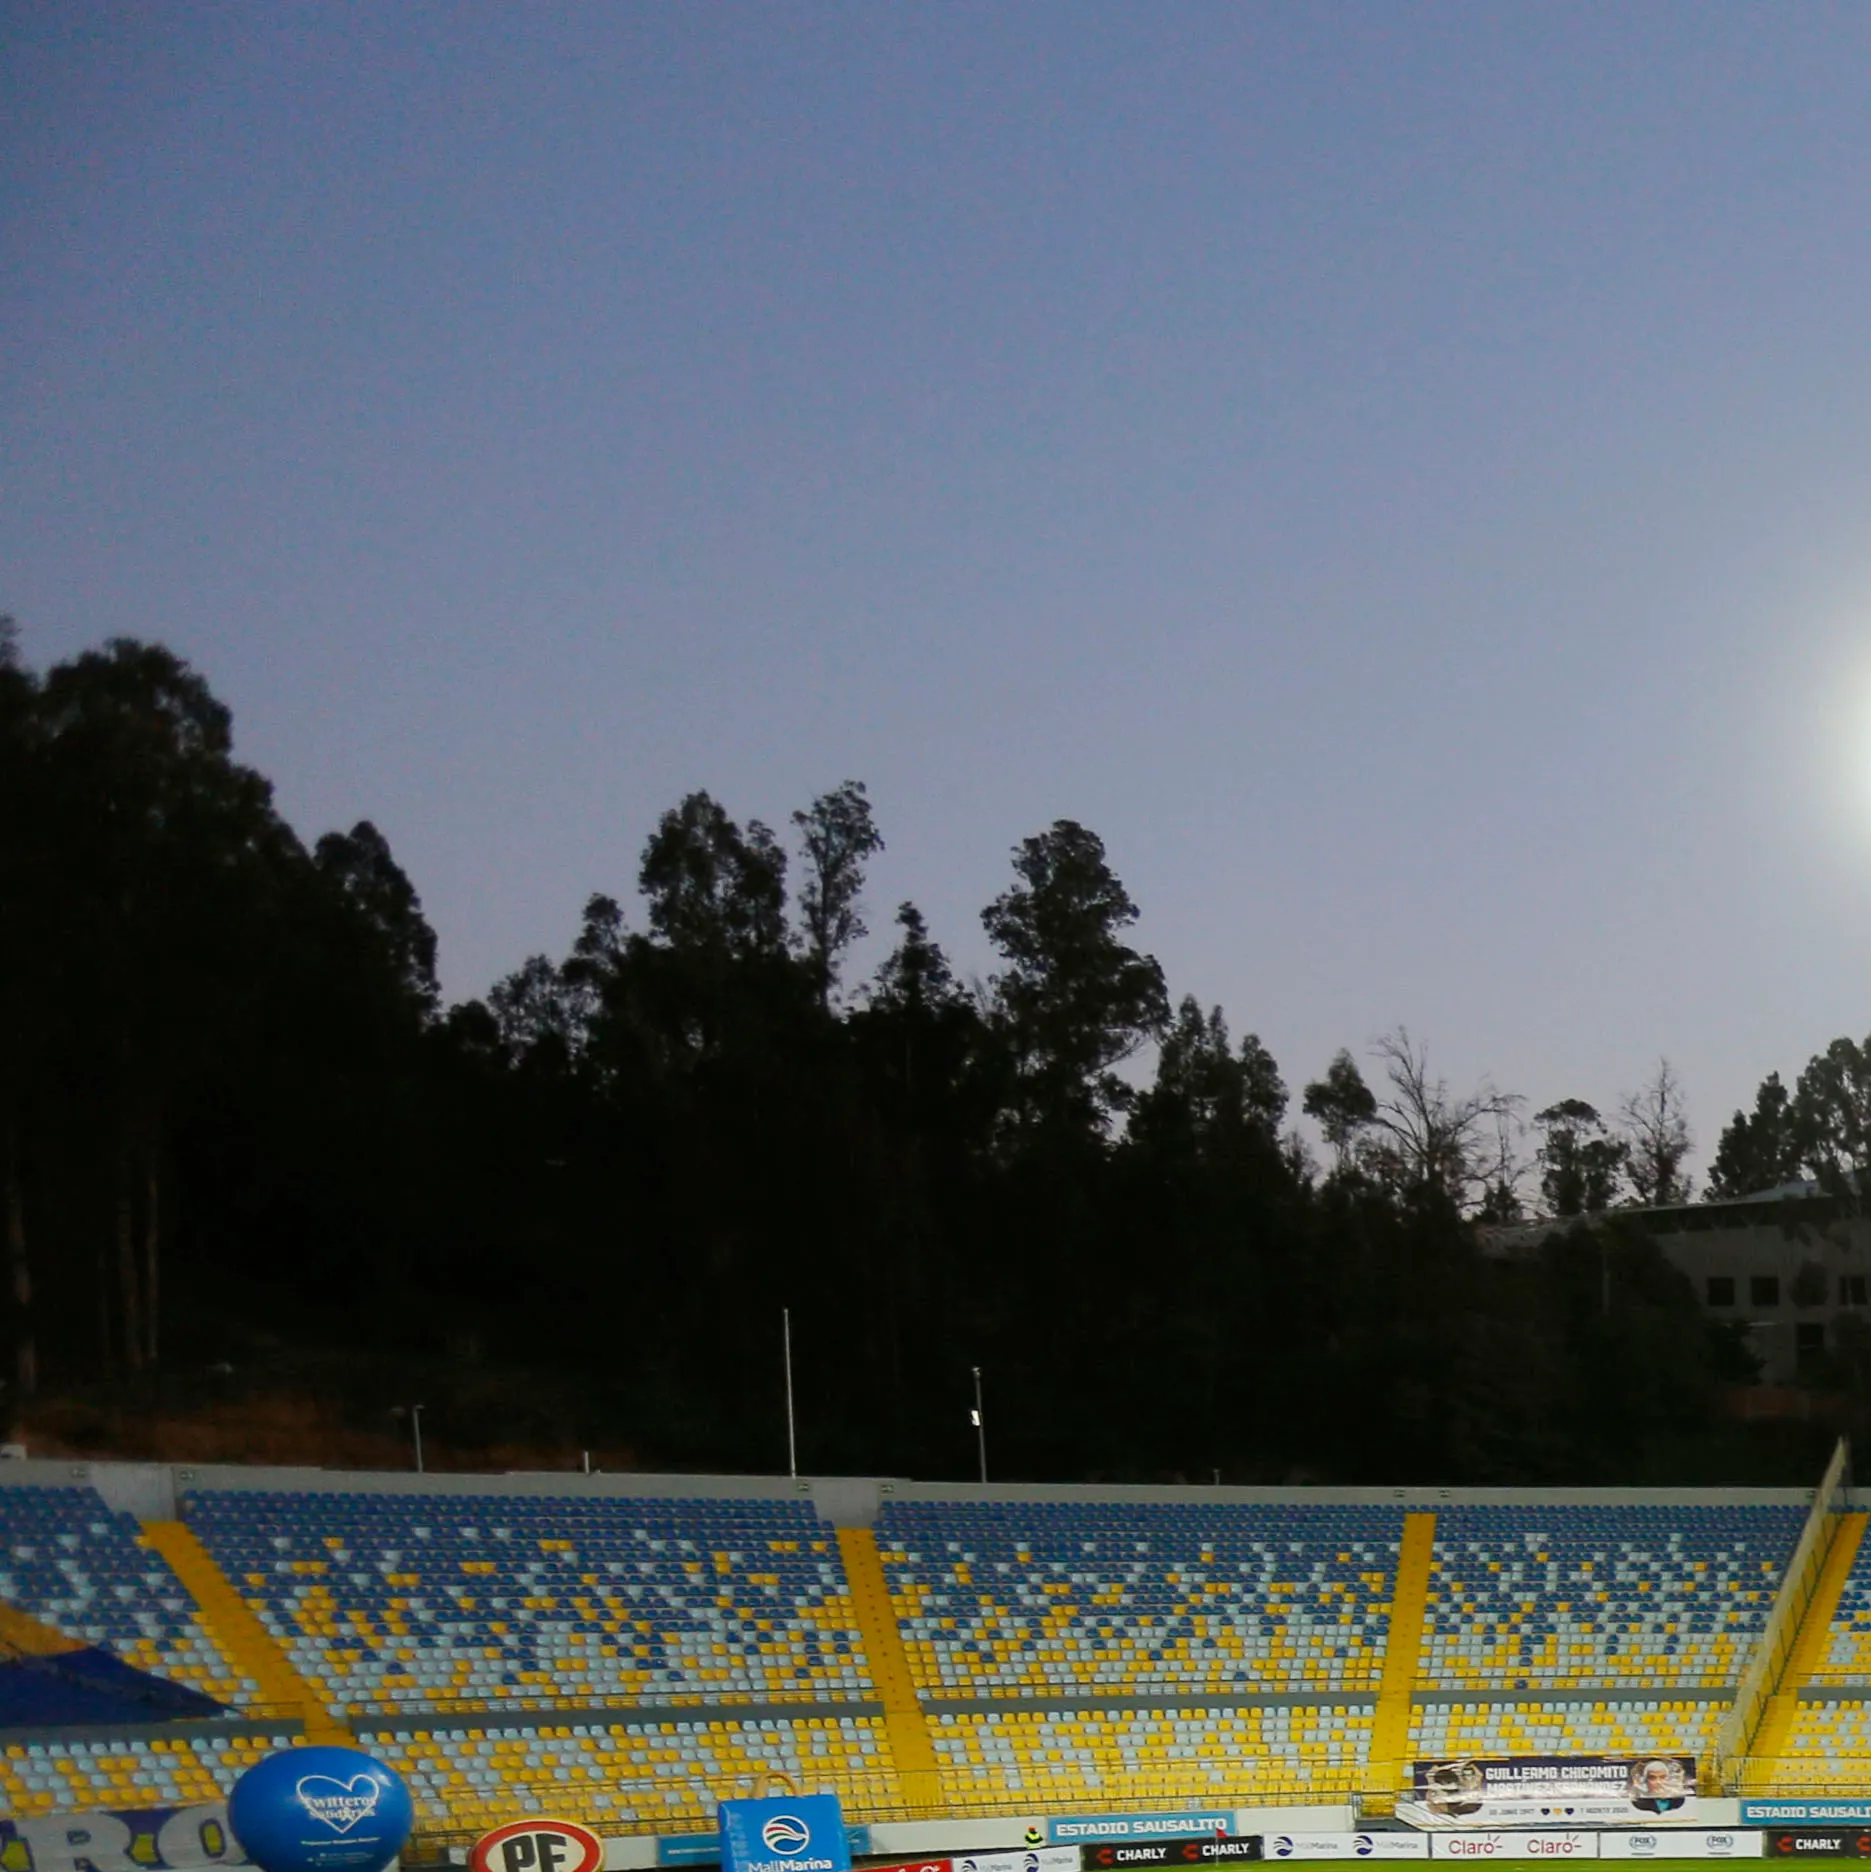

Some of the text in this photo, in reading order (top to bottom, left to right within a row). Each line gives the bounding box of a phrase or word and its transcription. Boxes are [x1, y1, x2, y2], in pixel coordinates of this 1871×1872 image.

[1485, 1766, 1628, 1780] GUILLERMO CHICOMITO
[1746, 1806, 1807, 1819] ESTADIO
[1056, 1818, 1228, 1837] ESTADIO SAUSALITO
[1202, 1842, 1249, 1857] CHARLY
[1448, 1839, 1495, 1855] Claro
[1527, 1839, 1573, 1855] Claro
[1795, 1838, 1841, 1850] CHARLY
[1116, 1847, 1167, 1862] CHARLY
